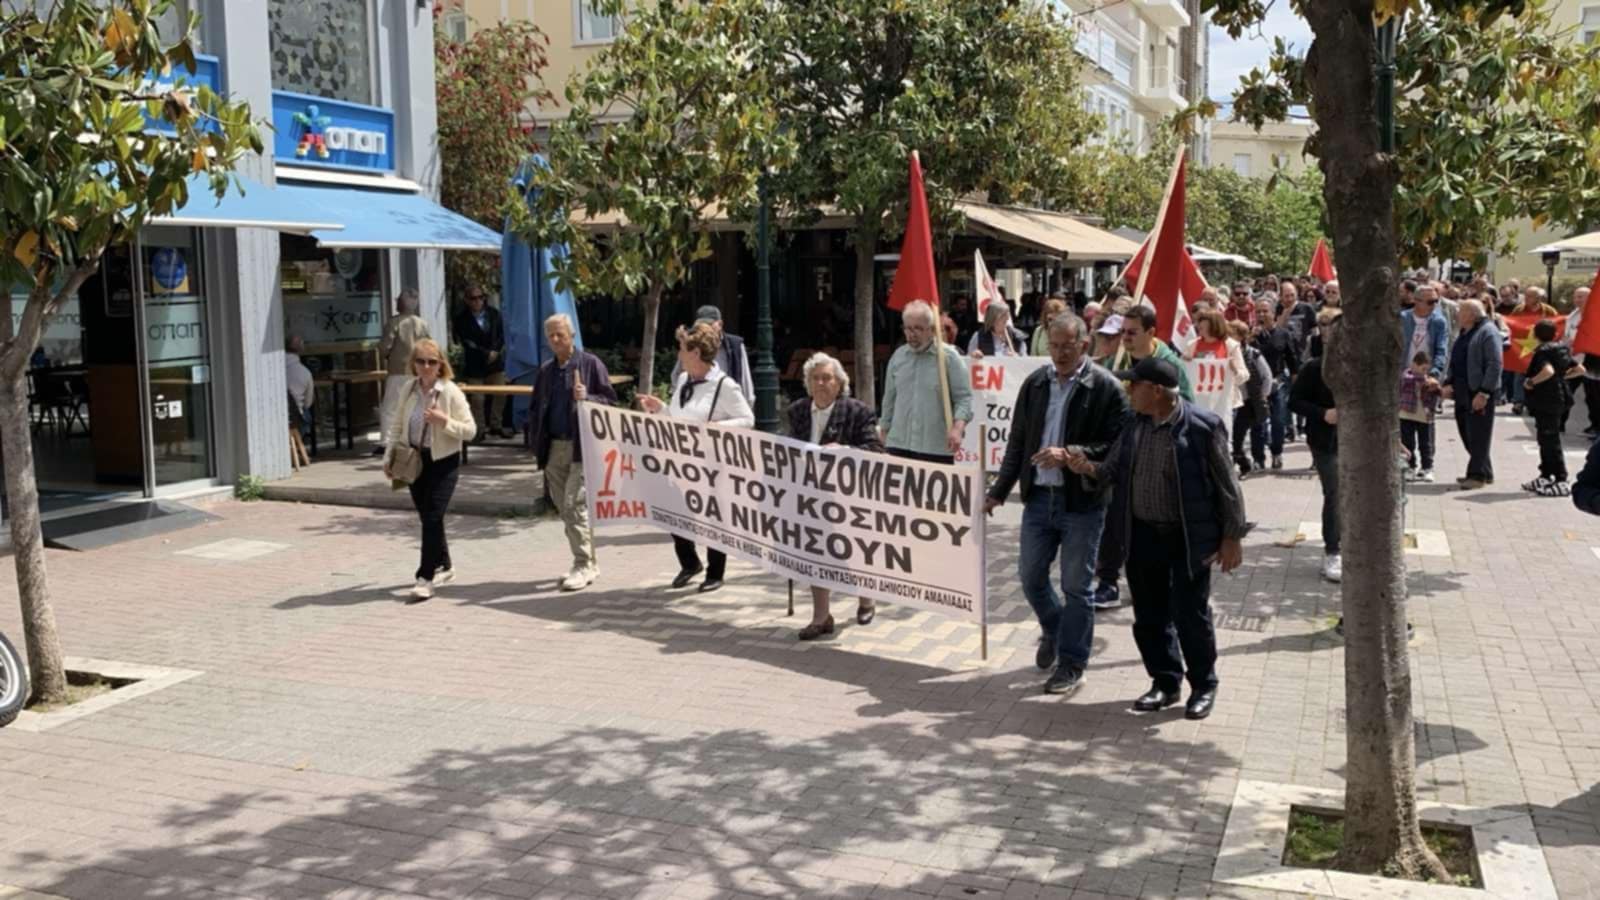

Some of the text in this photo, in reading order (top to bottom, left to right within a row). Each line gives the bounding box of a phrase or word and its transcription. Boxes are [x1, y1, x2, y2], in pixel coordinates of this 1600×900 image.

[590, 408, 971, 516] ΟΙ ΑΓΩΝΕΣ ΤΩΝ ΕΡΓΑΖΟΜΕΝΩΝ
[641, 454, 971, 547] ΟΛΟΥ ΤΟΥ ΚΟΣΜΟΥ
[595, 500, 647, 519] ΜΑΗ
[685, 490, 913, 573] ΘΑ ΝΙΚΗΣΟΥΝ
[878, 582, 923, 600] ΔΗΜΟΣΙΟΥ
[924, 591, 973, 612] ΑΜΑΛΙΑΔΑΣ
